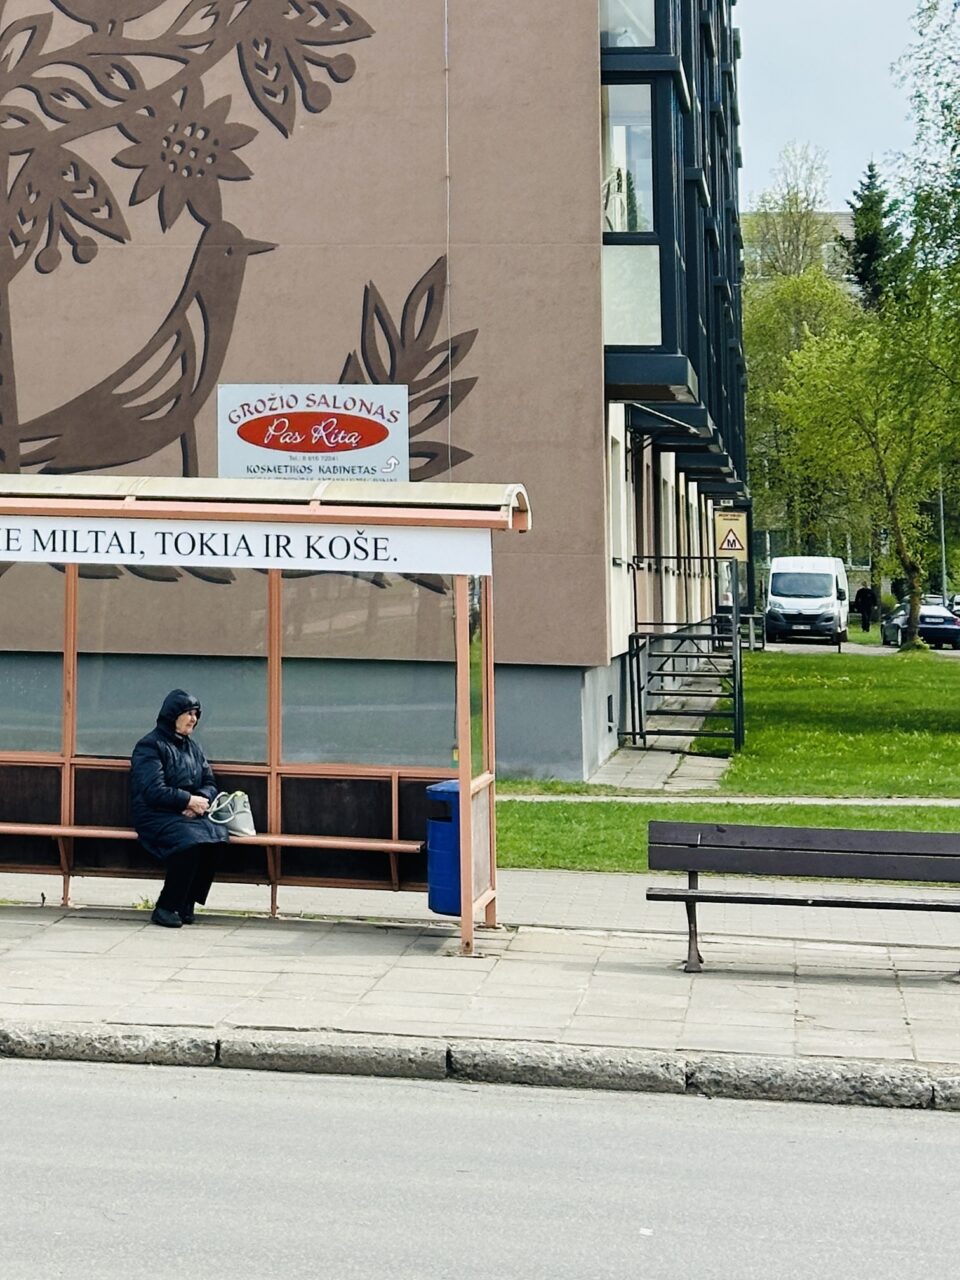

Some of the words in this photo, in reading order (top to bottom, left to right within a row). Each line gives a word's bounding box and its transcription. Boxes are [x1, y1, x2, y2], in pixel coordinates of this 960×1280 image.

[228, 393, 299, 424] GROŽIO
[305, 393, 401, 424] SALONAS
[264, 418, 305, 444] Pas
[246, 464, 313, 475] KOSMETIKOS
[318, 465, 377, 476] KABINETAS
[32, 528, 146, 560] MILTAI,
[154, 531, 255, 558] TOKIA
[263, 534, 295, 558] IR
[304, 529, 398, 562] KOŠE.
